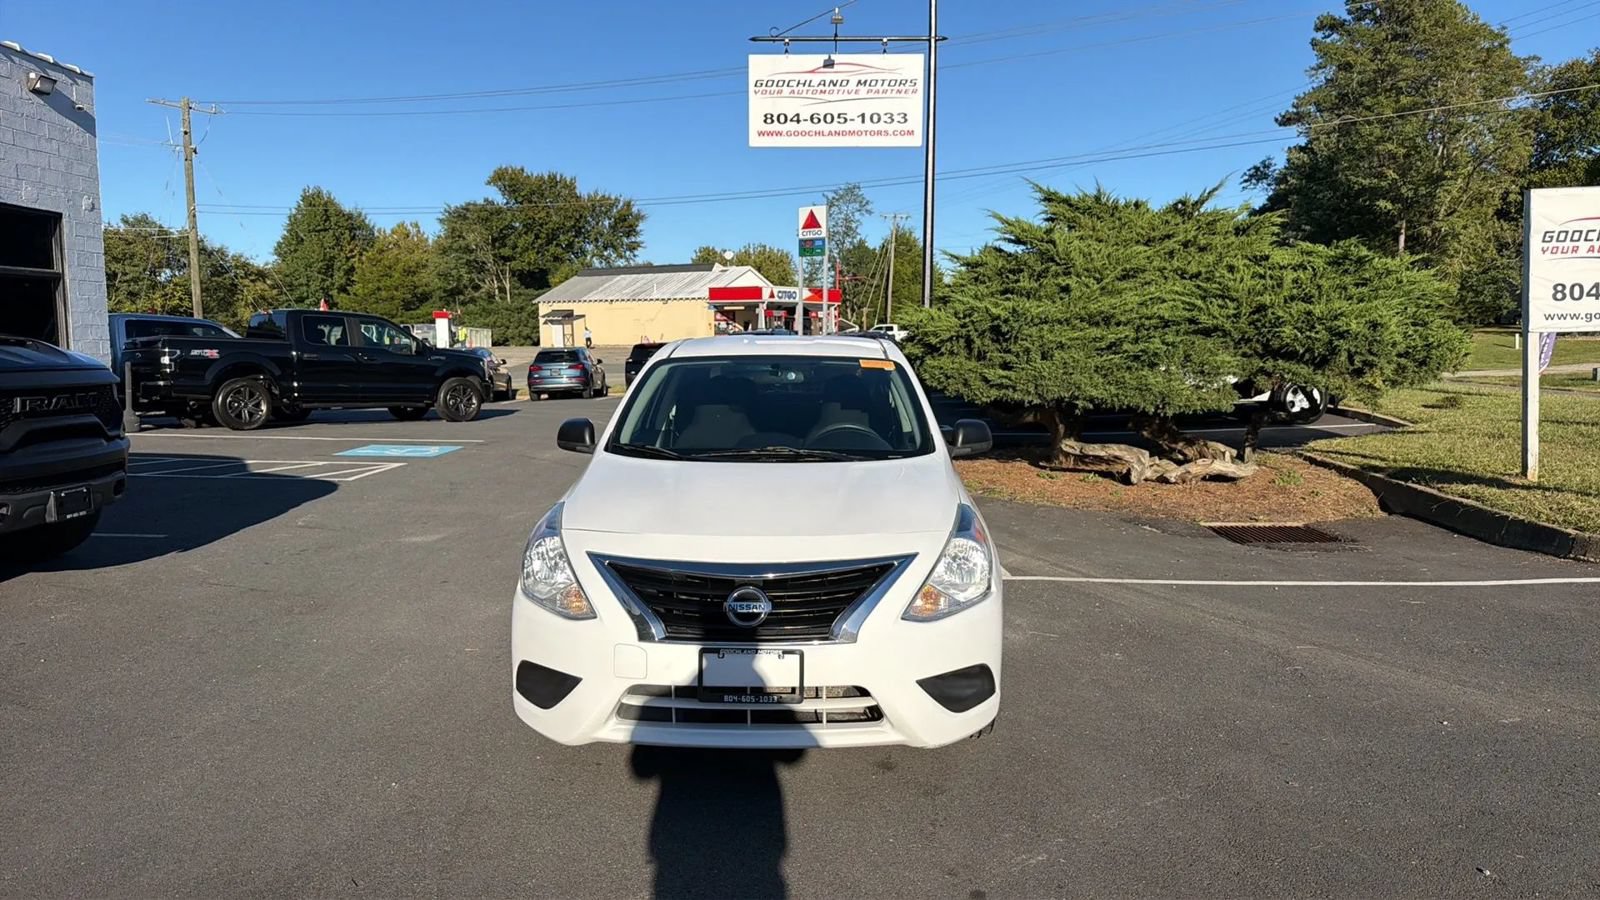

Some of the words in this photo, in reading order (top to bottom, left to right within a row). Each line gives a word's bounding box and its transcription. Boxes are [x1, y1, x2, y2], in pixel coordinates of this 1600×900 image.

[754, 79, 849, 88] GOOCHLAND
[856, 78, 918, 88] MOTORS
[763, 112, 908, 125] 804-605-1033
[757, 129, 915, 137] WWW.GOOCHLANDMOTORS.COM
[1541, 245, 1580, 255] YOUR
[777, 290, 797, 300] CITGO
[1551, 282, 1600, 302] 804
[1543, 312, 1600, 323] www.go
[11, 392, 99, 414] RAM
[728, 603, 766, 611] NISSAN
[723, 695, 778, 703] 804-605-1033
